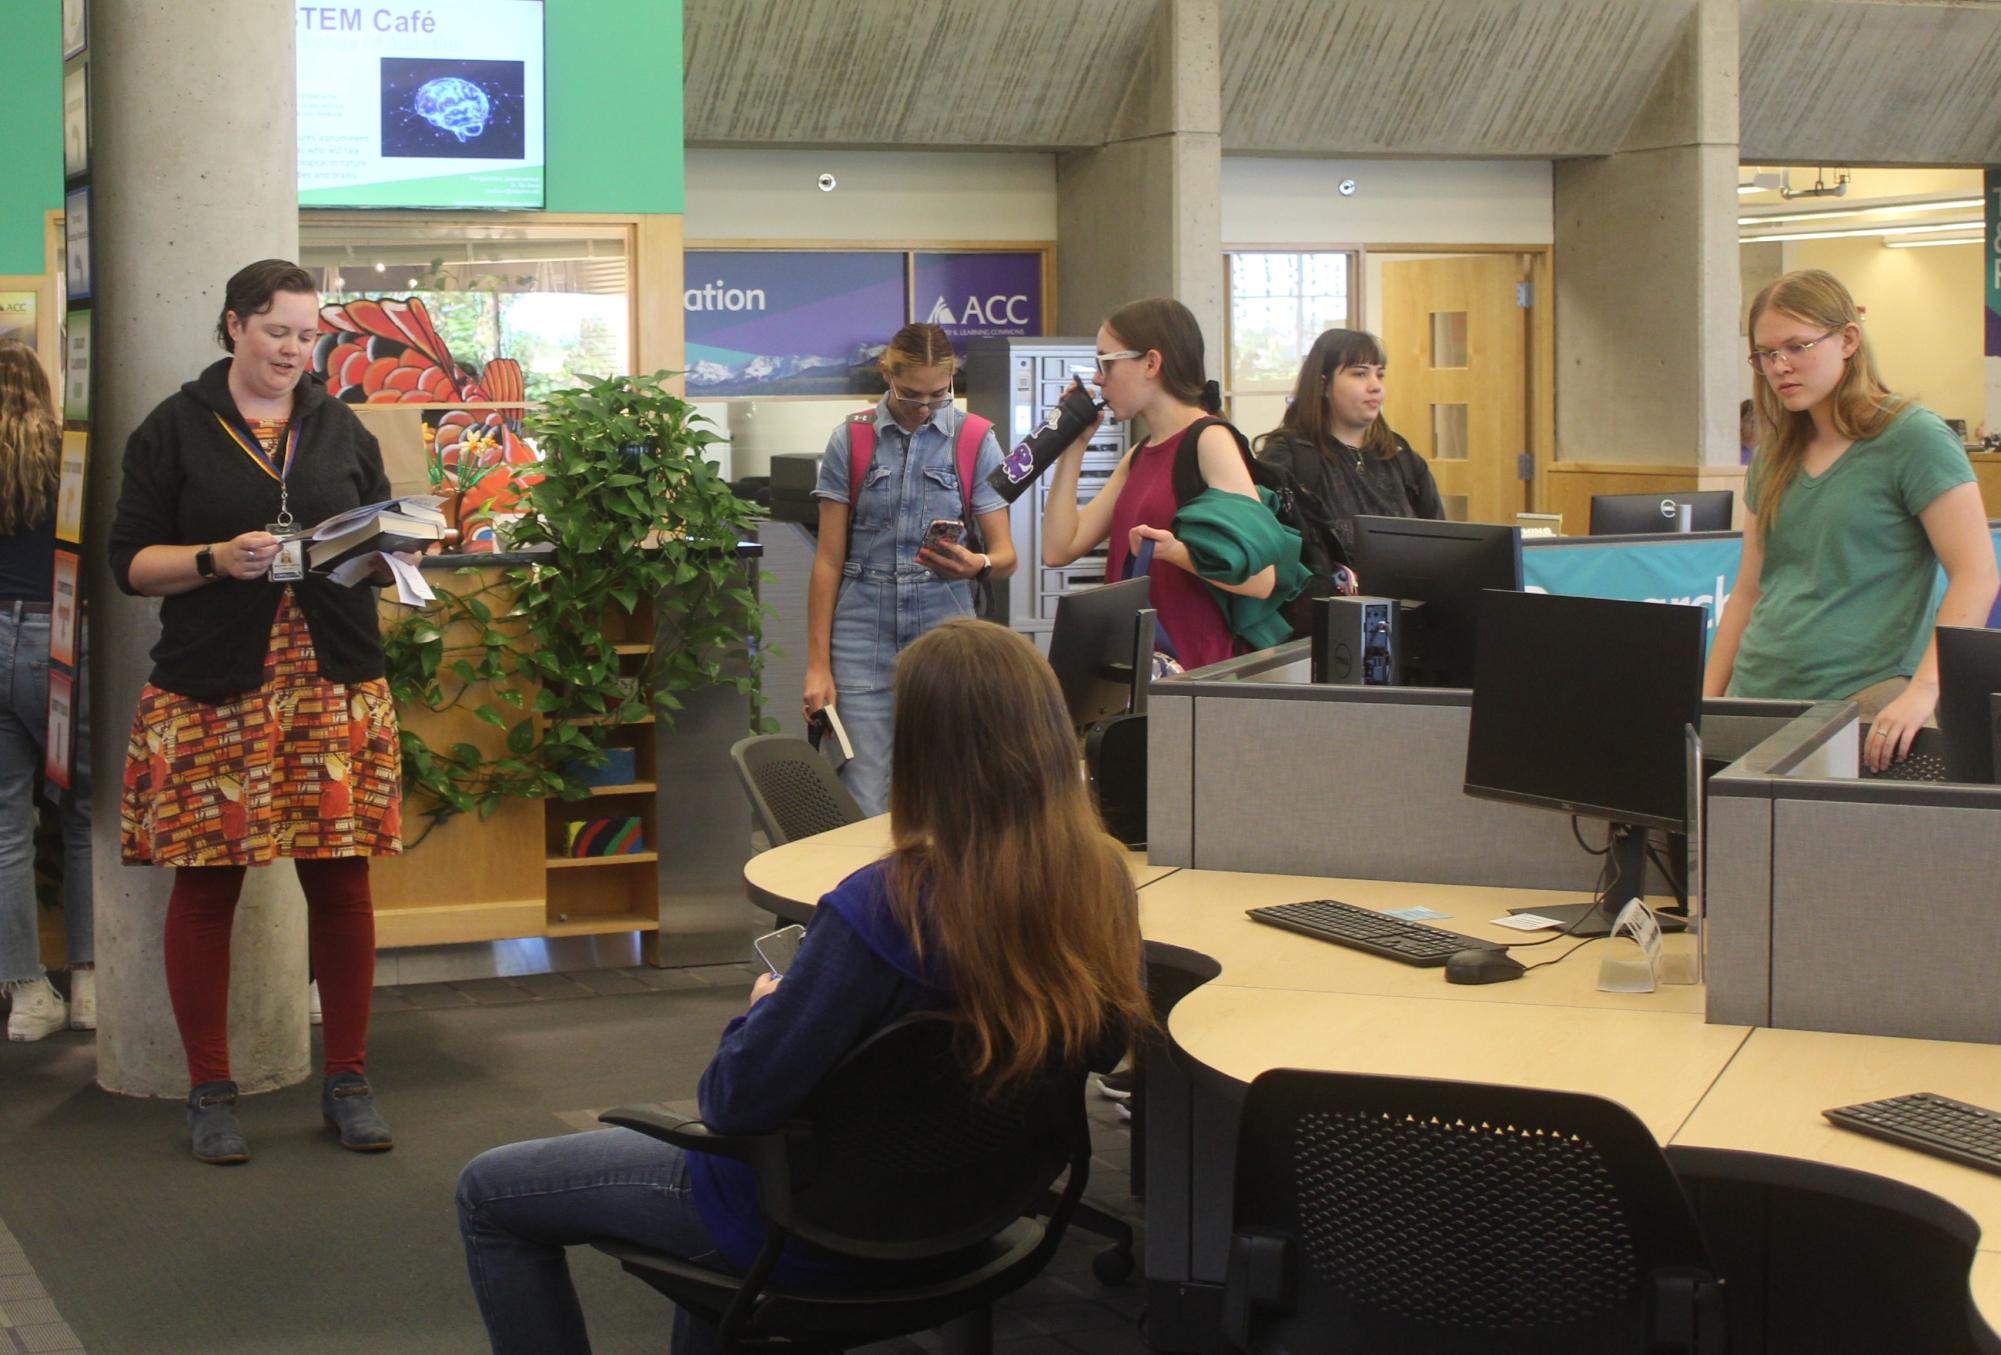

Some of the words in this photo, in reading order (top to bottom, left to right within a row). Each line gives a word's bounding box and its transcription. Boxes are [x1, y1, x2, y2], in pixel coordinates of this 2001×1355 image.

[296, 6, 362, 32] TEM
[373, 8, 436, 33] Café
[6, 303, 27, 312] ACC
[683, 279, 766, 312] ation
[961, 294, 1030, 325] ACC
